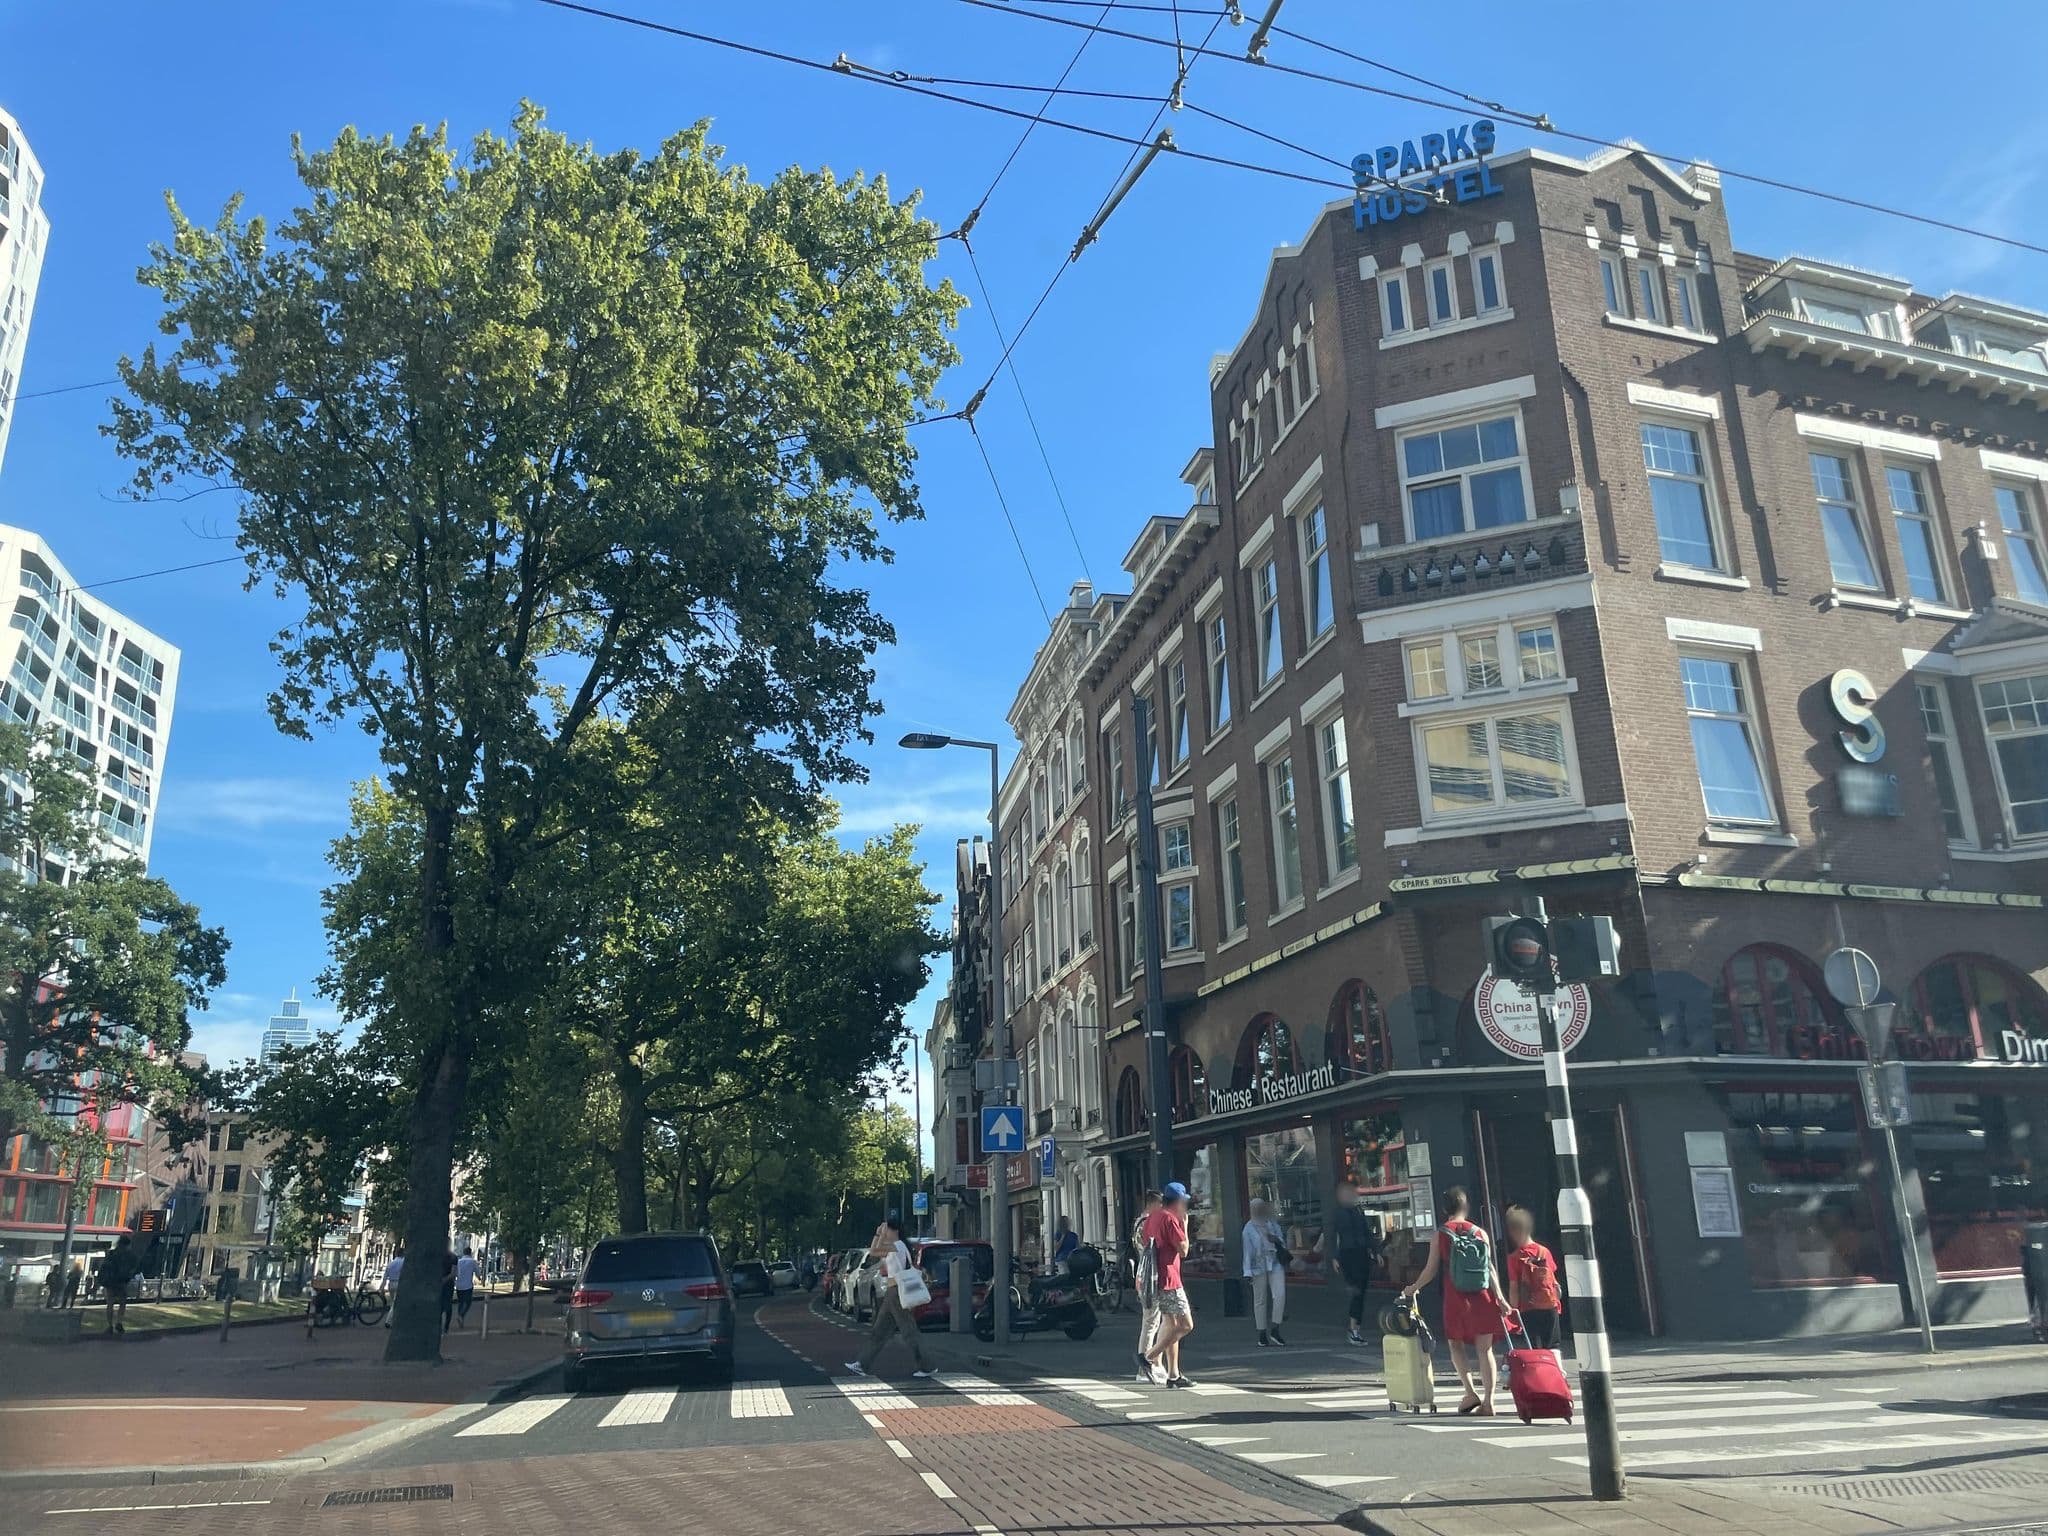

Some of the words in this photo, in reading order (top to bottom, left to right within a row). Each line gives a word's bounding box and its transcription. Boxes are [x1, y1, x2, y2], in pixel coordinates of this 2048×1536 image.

[1351, 119, 1496, 187] SPARKS
[1353, 163, 1504, 232] HOSTEL
[1830, 668, 1886, 763] S
[1401, 879, 1429, 889] SPARKS
[1432, 875, 1462, 885] HOSTEL
[1494, 1001, 1532, 1014] China
[1209, 1088, 1253, 1114] Chinese
[1261, 1058, 1334, 1104] Restaurant
[1043, 1141, 1051, 1160] P
